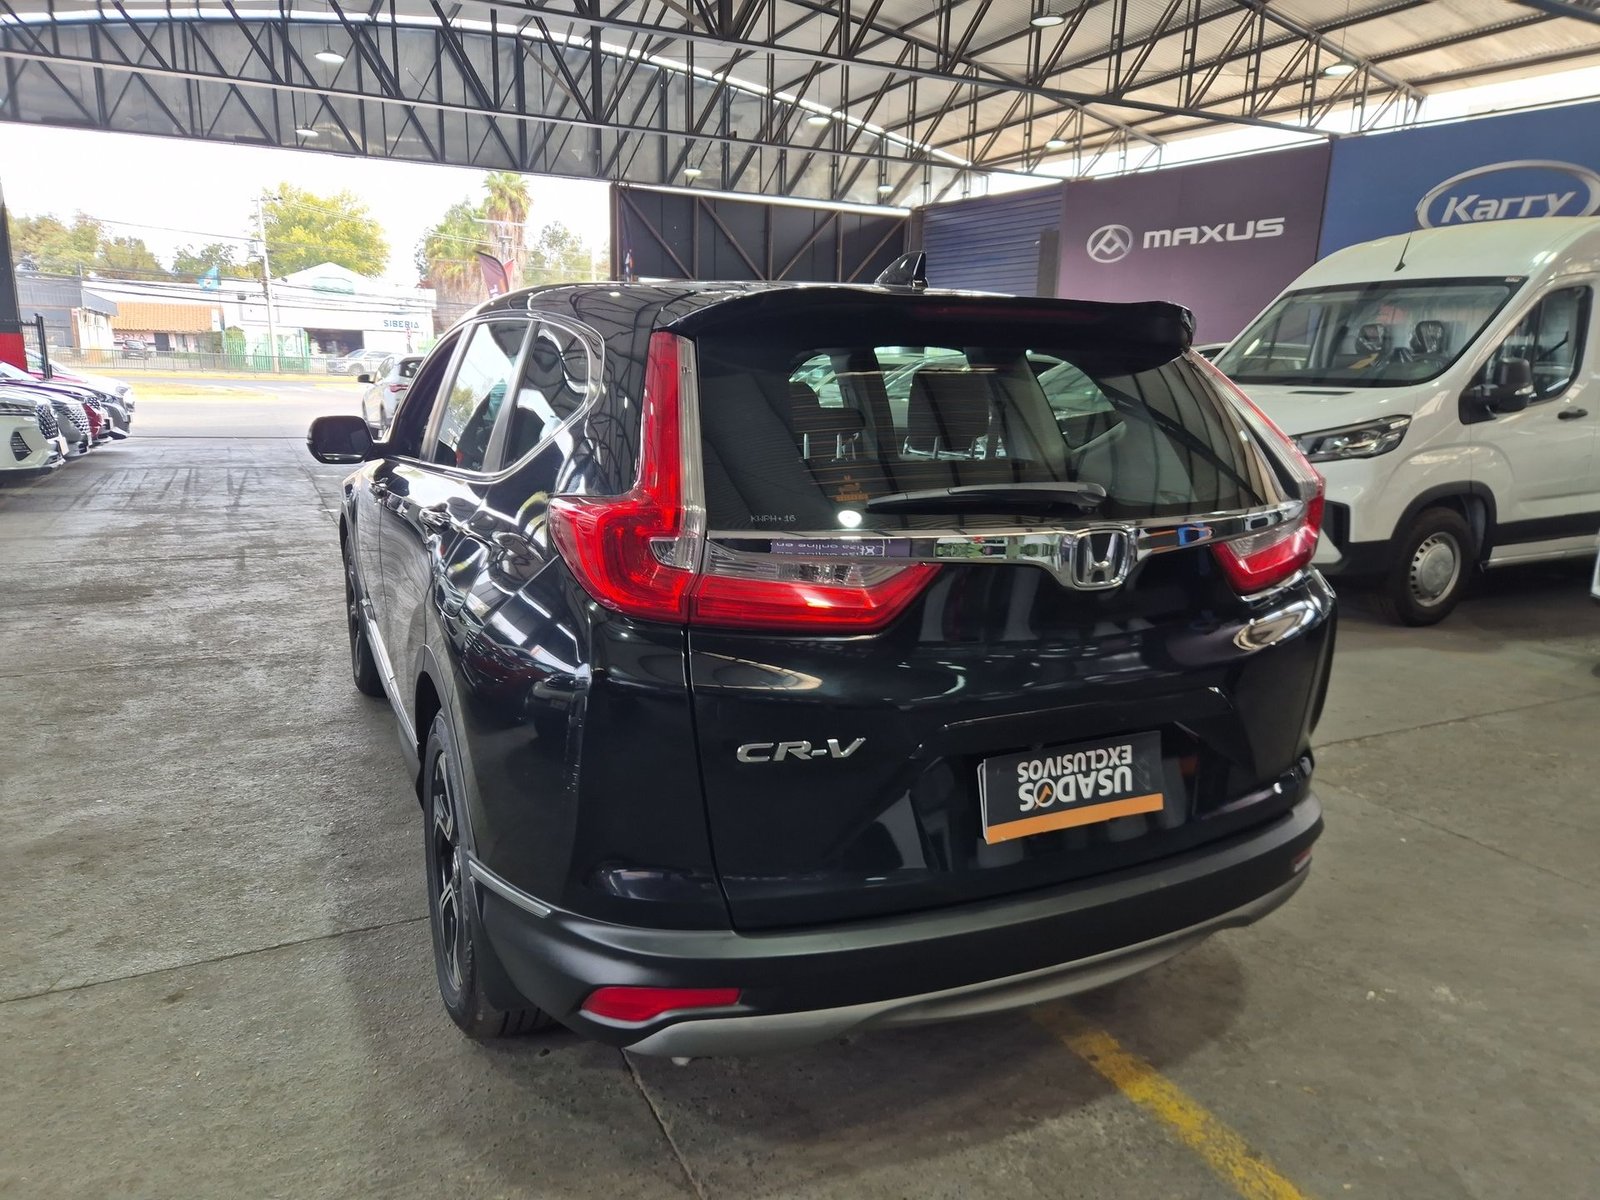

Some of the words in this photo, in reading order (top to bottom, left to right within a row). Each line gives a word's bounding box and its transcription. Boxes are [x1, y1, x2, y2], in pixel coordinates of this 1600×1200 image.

[1440, 191, 1577, 223] Karry
[1143, 217, 1286, 249] MAXUS
[383, 319, 420, 329] SIBERIA
[736, 737, 867, 763] CR-V
[1017, 744, 1133, 783] EXCLUSIVOS
[1018, 765, 1133, 812] USADOS
